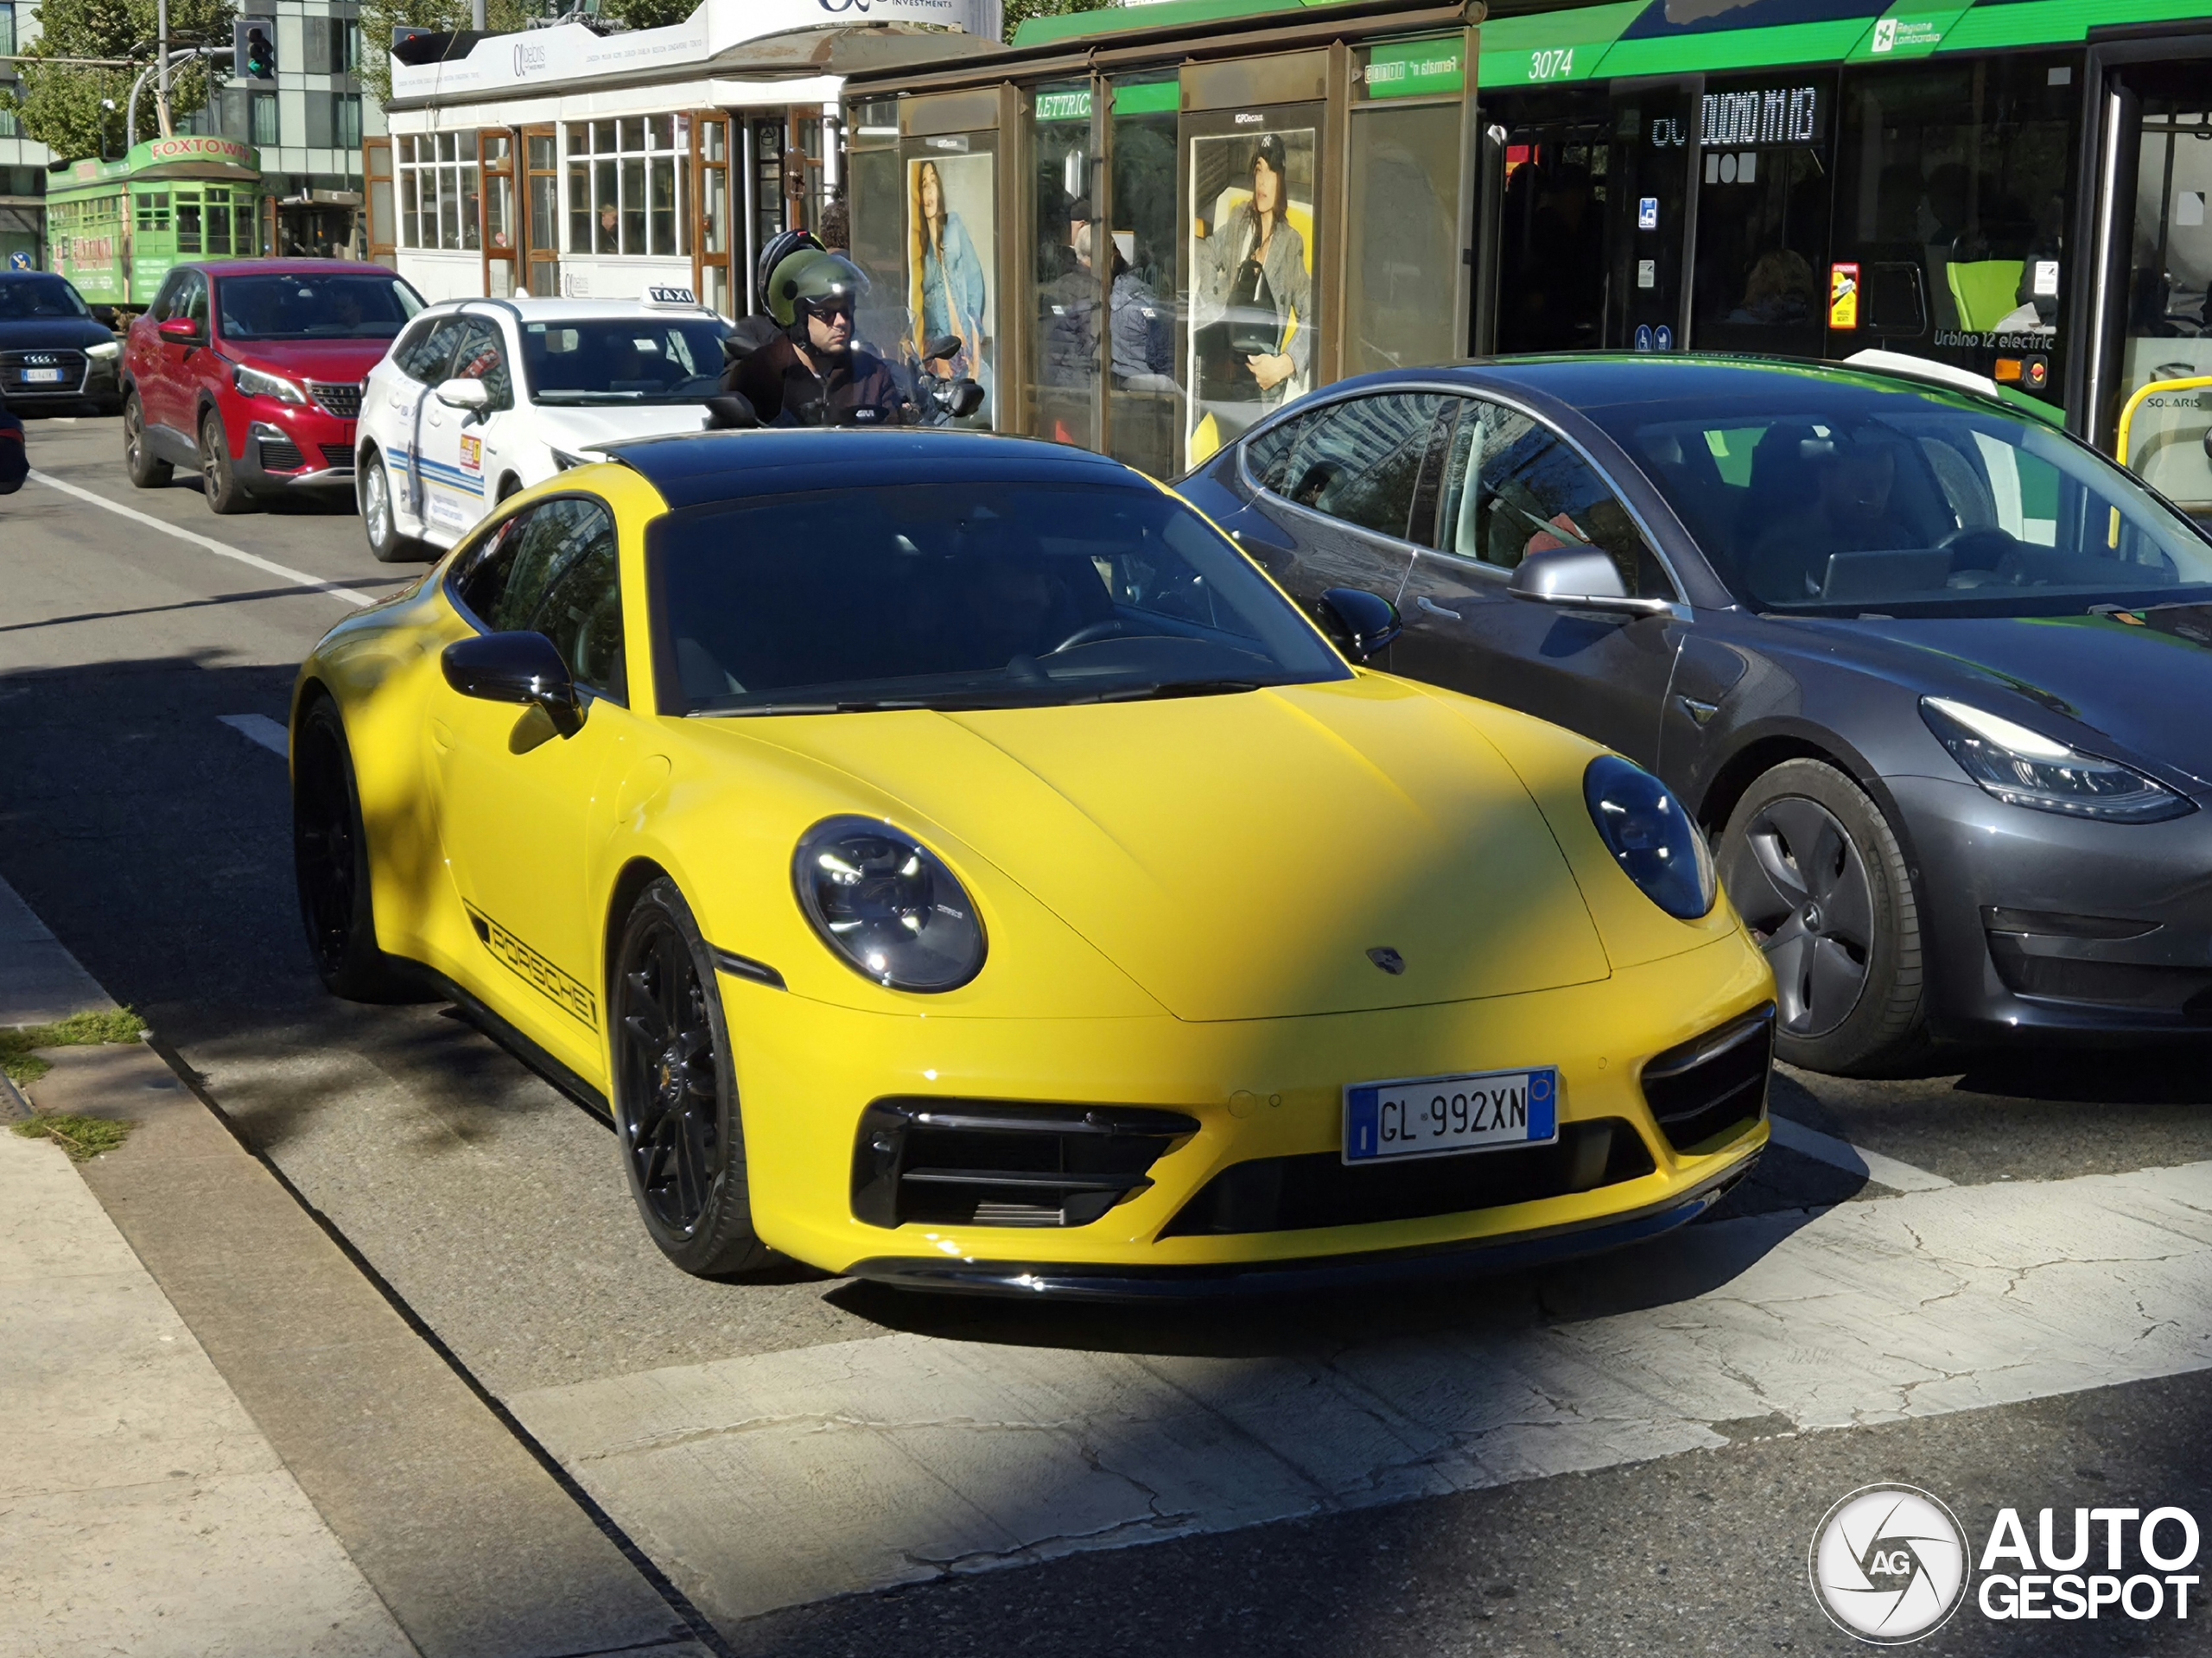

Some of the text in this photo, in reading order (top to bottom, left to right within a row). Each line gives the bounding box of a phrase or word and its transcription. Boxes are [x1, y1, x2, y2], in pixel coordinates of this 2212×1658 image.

[1897, 22, 1933, 35] Regione
[1894, 34, 1941, 45] Lombardia
[1529, 48, 1573, 79] 3074
[1700, 86, 1815, 145] DUOMO M1 M3
[152, 139, 251, 162] FOXTOWN
[650, 289, 693, 302] TAXI
[1934, 330, 2055, 350] Urbino 12 electric
[2147, 397, 2202, 408] SOLARIS
[492, 927, 589, 1019] PORSCHE
[1381, 1100, 1417, 1142] GL
[1431, 1086, 1527, 1137] 992XN
